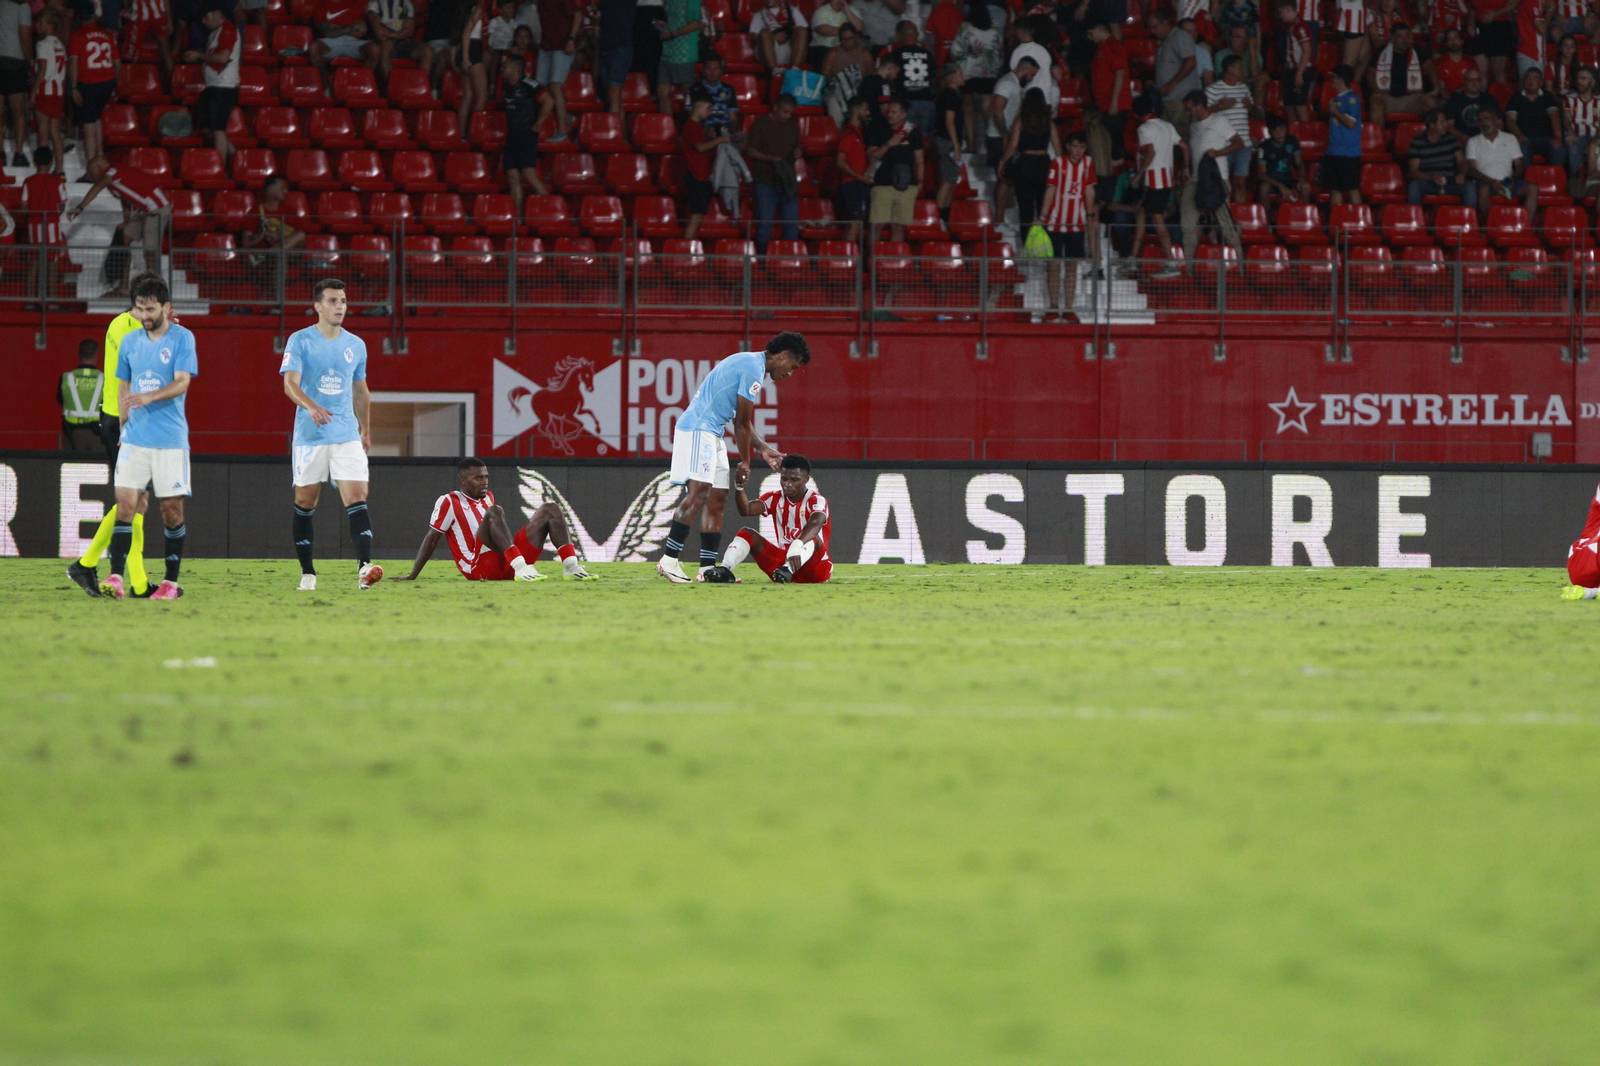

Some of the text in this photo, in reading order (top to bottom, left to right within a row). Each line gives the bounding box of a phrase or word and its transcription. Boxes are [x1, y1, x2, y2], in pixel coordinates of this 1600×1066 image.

[86, 41, 113, 69] 23
[138, 378, 160, 386] Estrella
[320, 375, 342, 383] Estrella
[1320, 393, 1572, 426] ESTRELLA
[703, 443, 713, 461] 5
